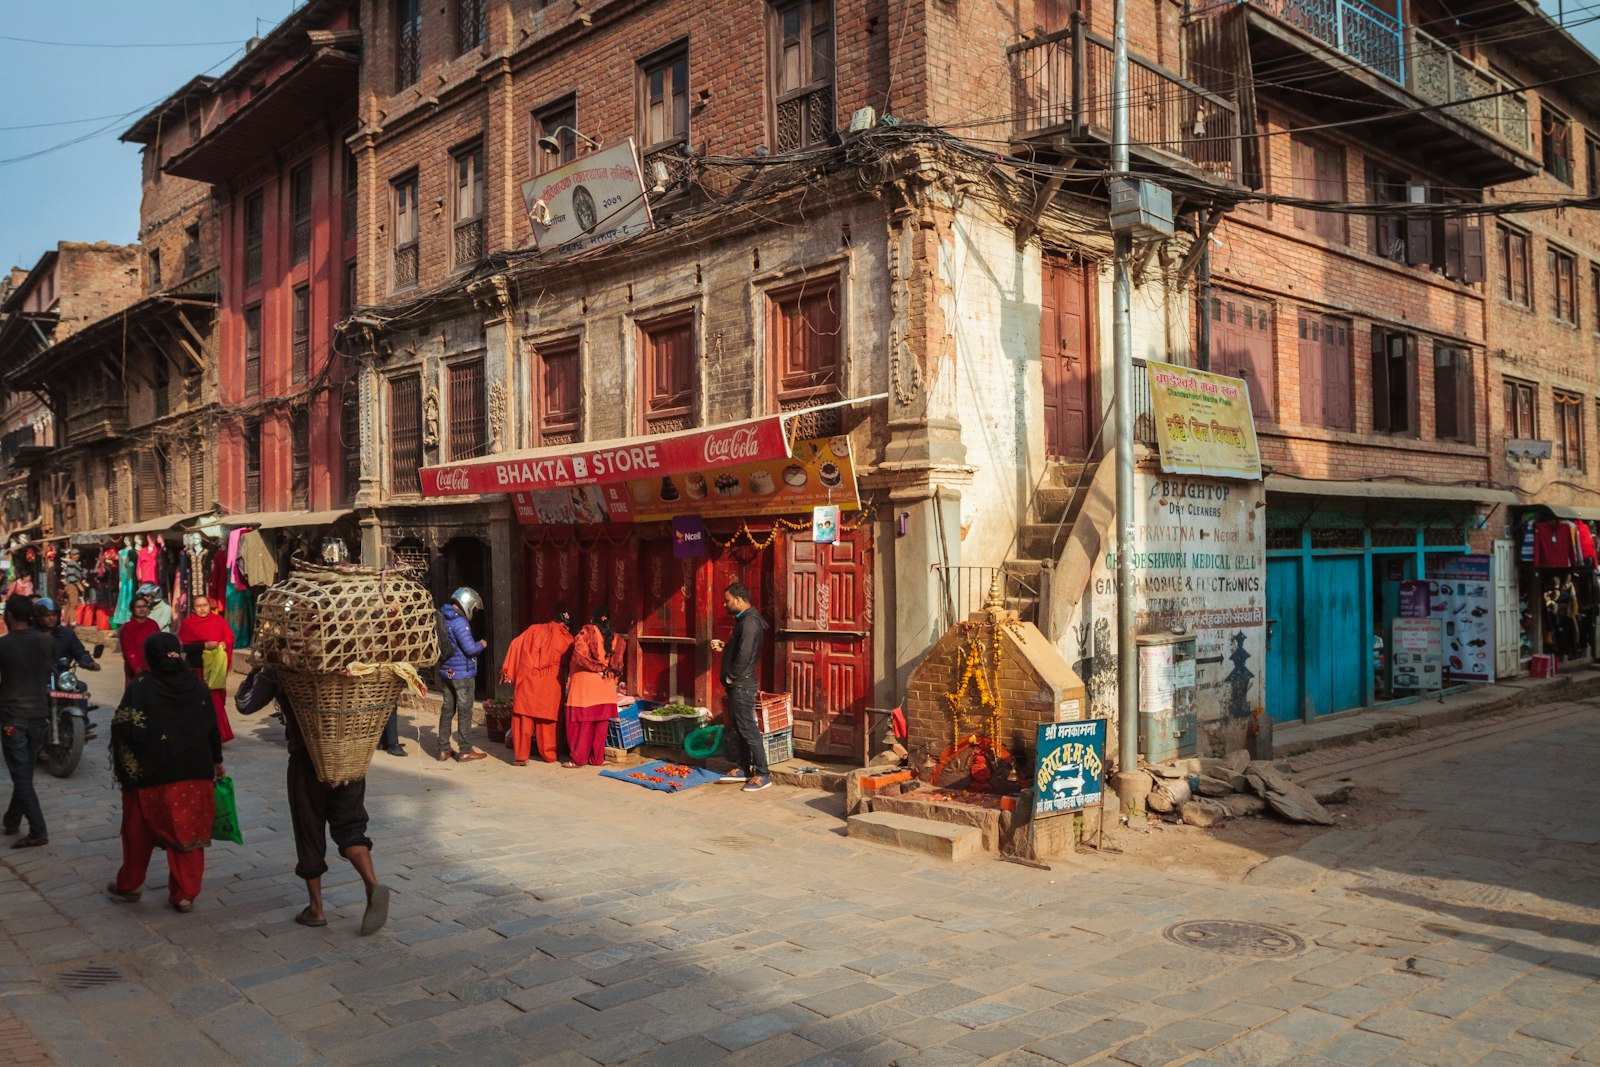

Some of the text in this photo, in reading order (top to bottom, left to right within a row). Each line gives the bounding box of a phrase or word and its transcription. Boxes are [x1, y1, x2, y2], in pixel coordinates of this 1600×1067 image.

[704, 425, 759, 463] Coca-Cola
[496, 445, 660, 485] BHAKTA B STORE
[609, 488, 618, 500] B
[1162, 480, 1229, 500] BRIGHTOP
[518, 506, 534, 516] STORE
[610, 502, 628, 513] STORE
[1169, 502, 1221, 518] DRY CLEANERS
[684, 532, 702, 541] Ncell
[1105, 553, 1187, 570] CHDESHWORI
[1191, 553, 1231, 570] MEDICAL
[1144, 576, 1183, 593] MOBILE
[1186, 576, 1193, 592] &
[1201, 609, 1232, 627] सहकारी
[1045, 723, 1097, 740] श्री मनकामना
